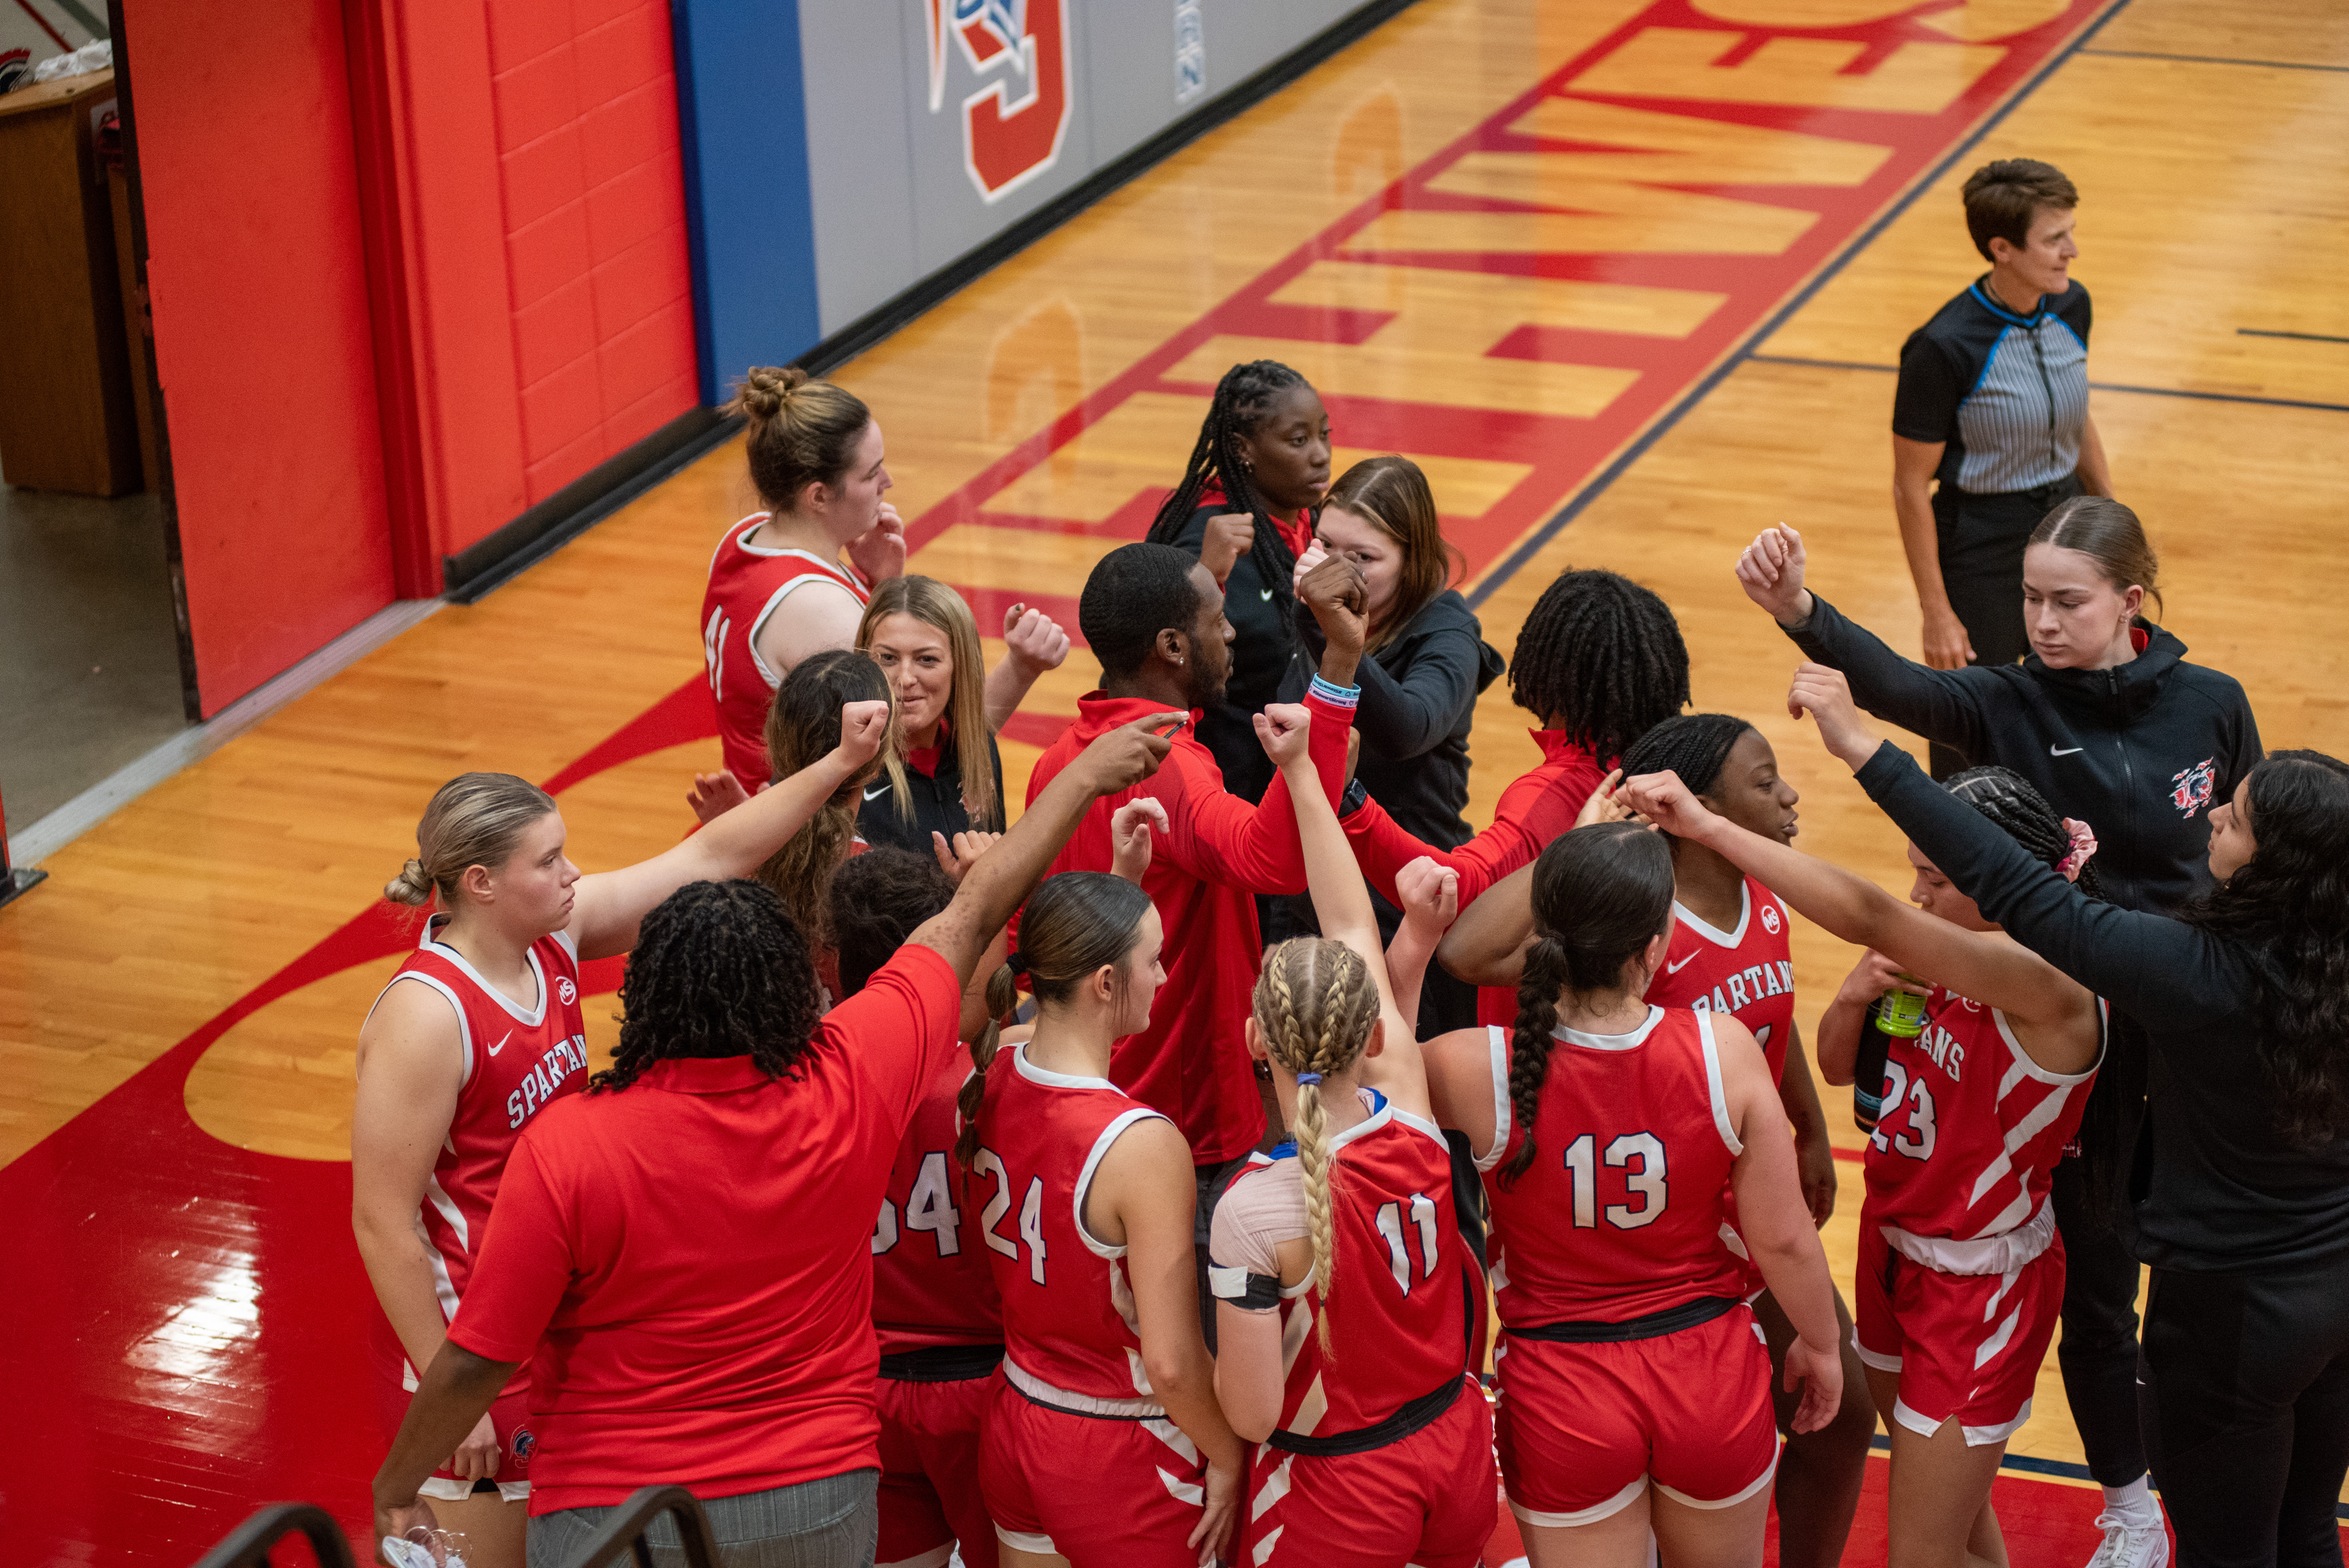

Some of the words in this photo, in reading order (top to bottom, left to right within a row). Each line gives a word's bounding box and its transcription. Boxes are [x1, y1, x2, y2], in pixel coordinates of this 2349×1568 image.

[1691, 960, 1794, 1016] ARTAN
[1870, 1059, 1938, 1162] 23
[973, 1147, 1047, 1287] 24
[1564, 1131, 1668, 1230] 13
[1375, 1192, 1438, 1297] 11
